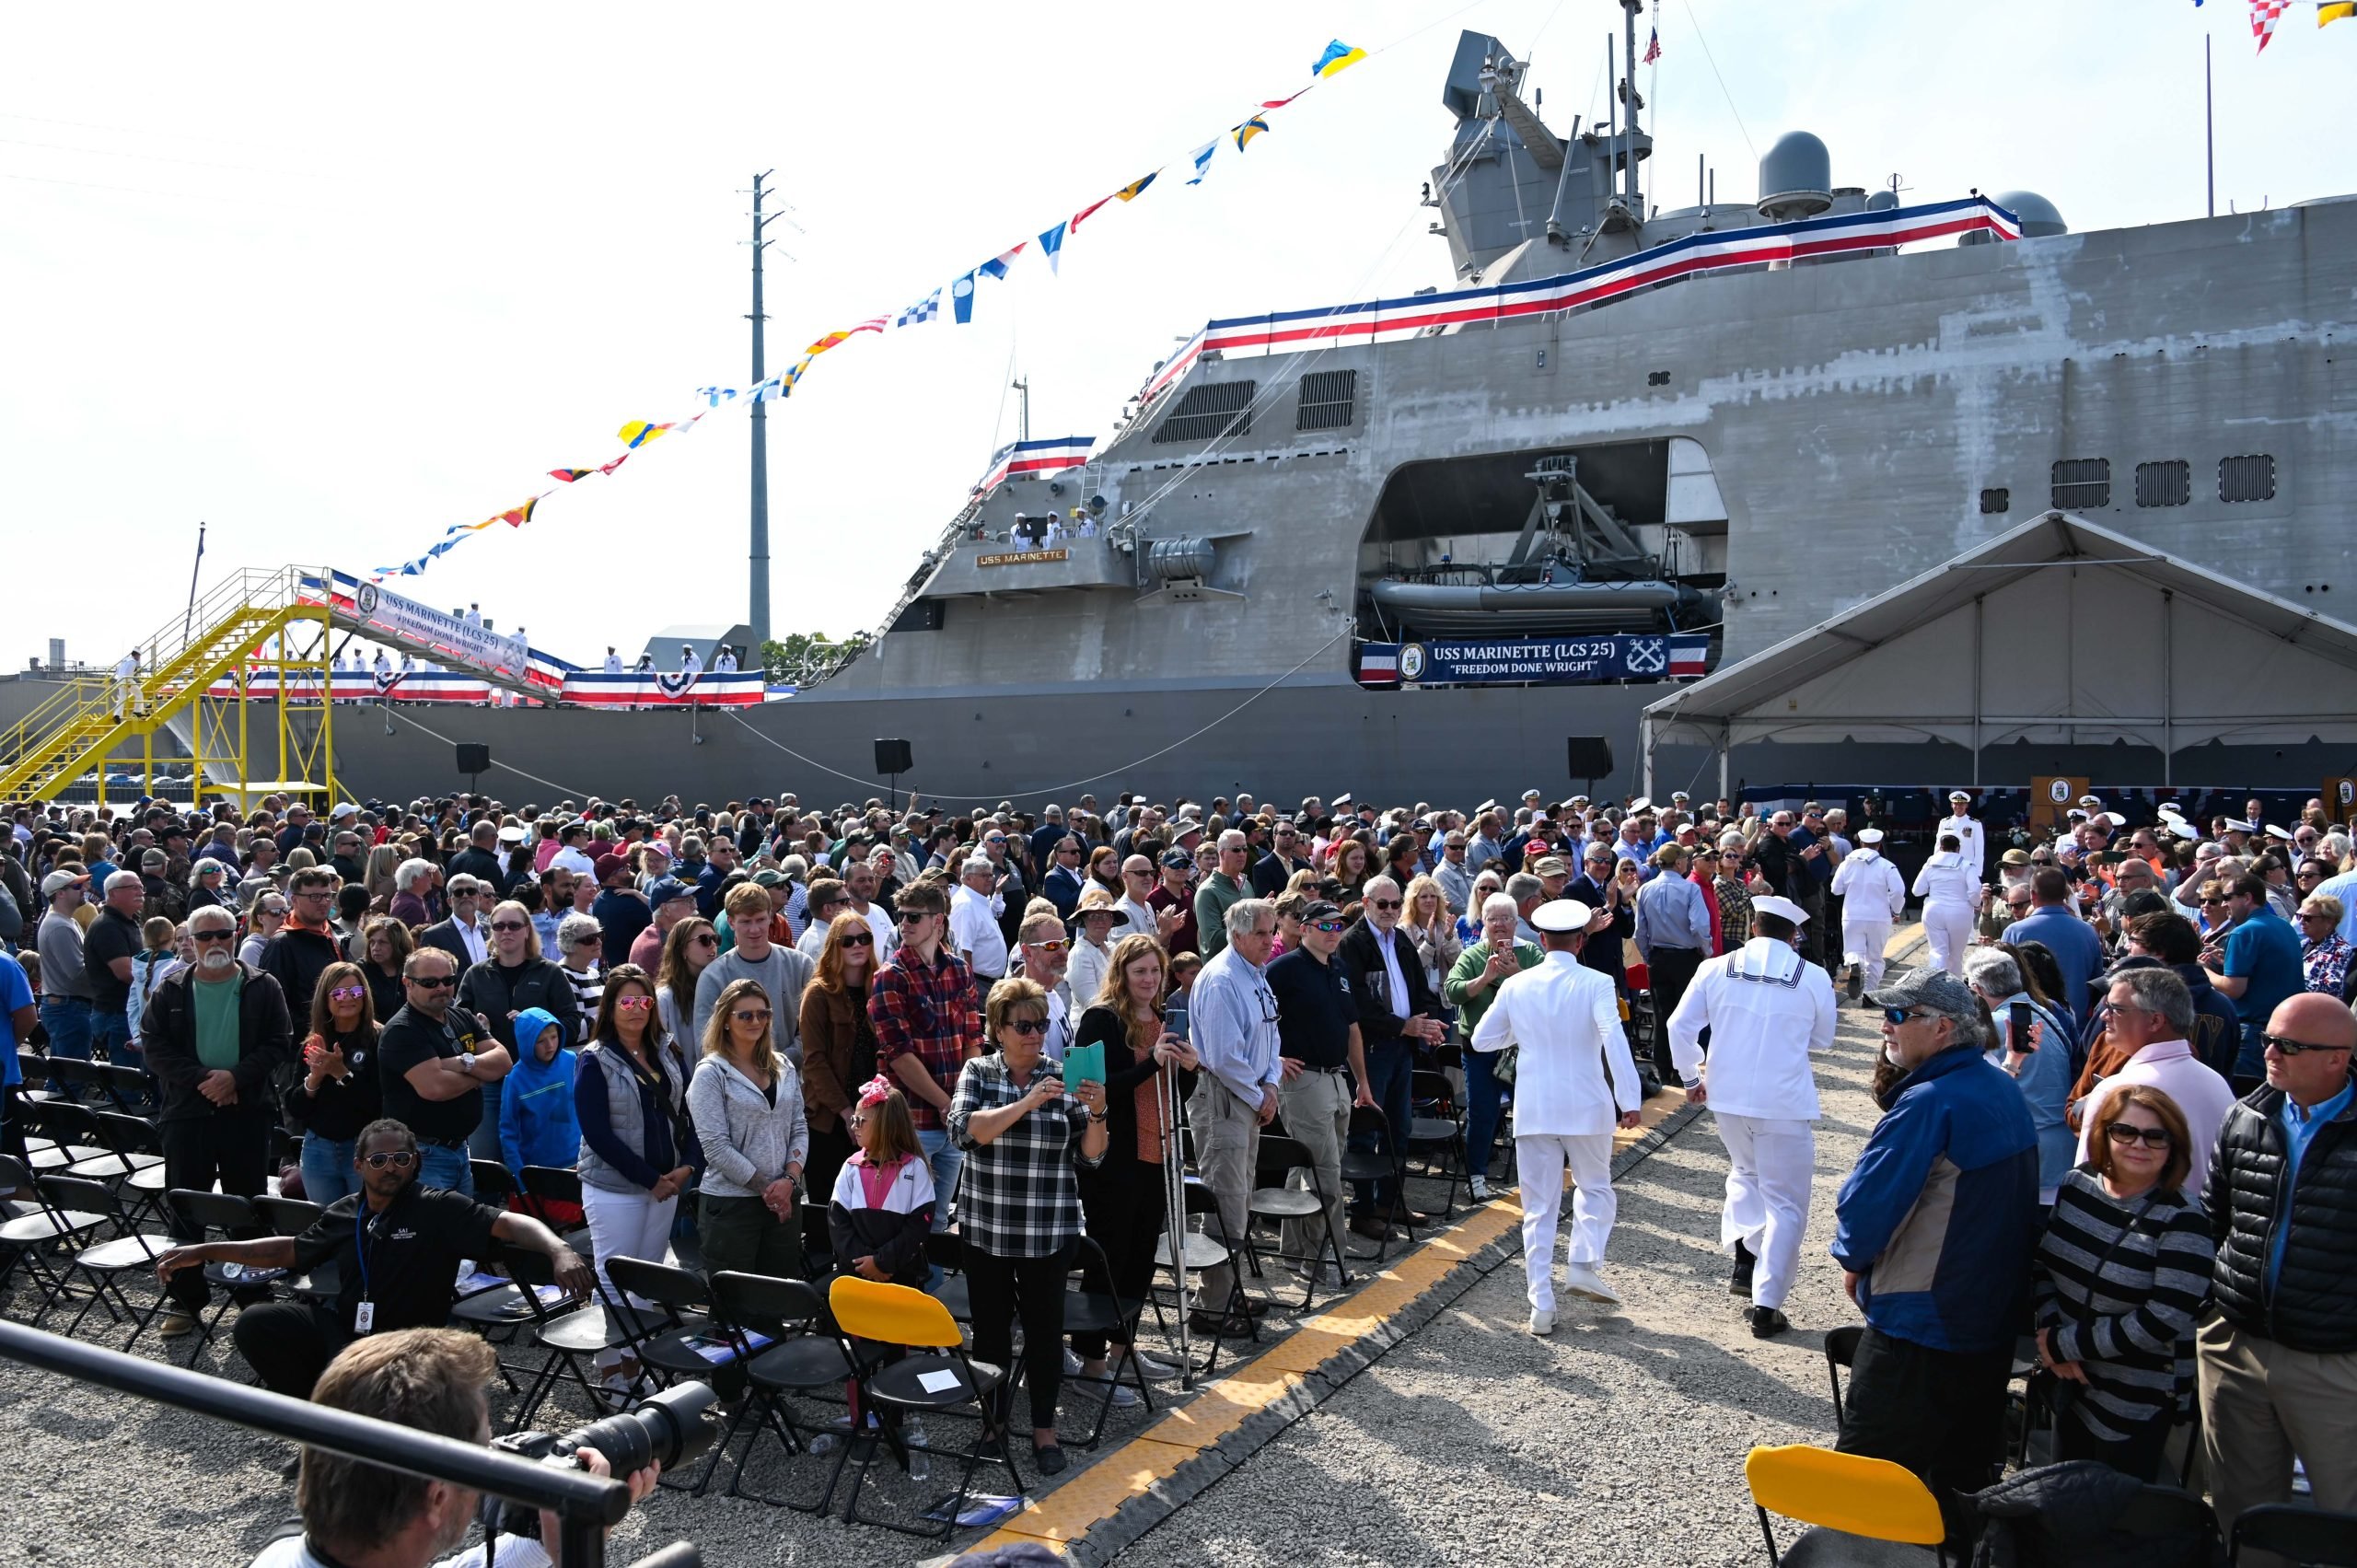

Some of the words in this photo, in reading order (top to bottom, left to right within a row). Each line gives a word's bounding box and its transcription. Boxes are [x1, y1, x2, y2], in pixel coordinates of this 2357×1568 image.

[981, 555, 1001, 564] USS
[1004, 551, 1062, 563] MARINETTE
[386, 594, 403, 610] USS
[405, 603, 461, 633] MARINETTE
[462, 625, 482, 641] (LCS
[483, 633, 499, 649] 25)
[434, 630, 454, 643] DONE
[1434, 647, 1460, 660] USS
[1463, 645, 1551, 660] MARINETTE
[1554, 643, 1587, 661] (LCS
[1591, 642, 1616, 659] 25)
[1450, 663, 1509, 675] “FREEDOM
[1511, 662, 1542, 673] DONE
[1544, 660, 1598, 672] WRIGHT”
